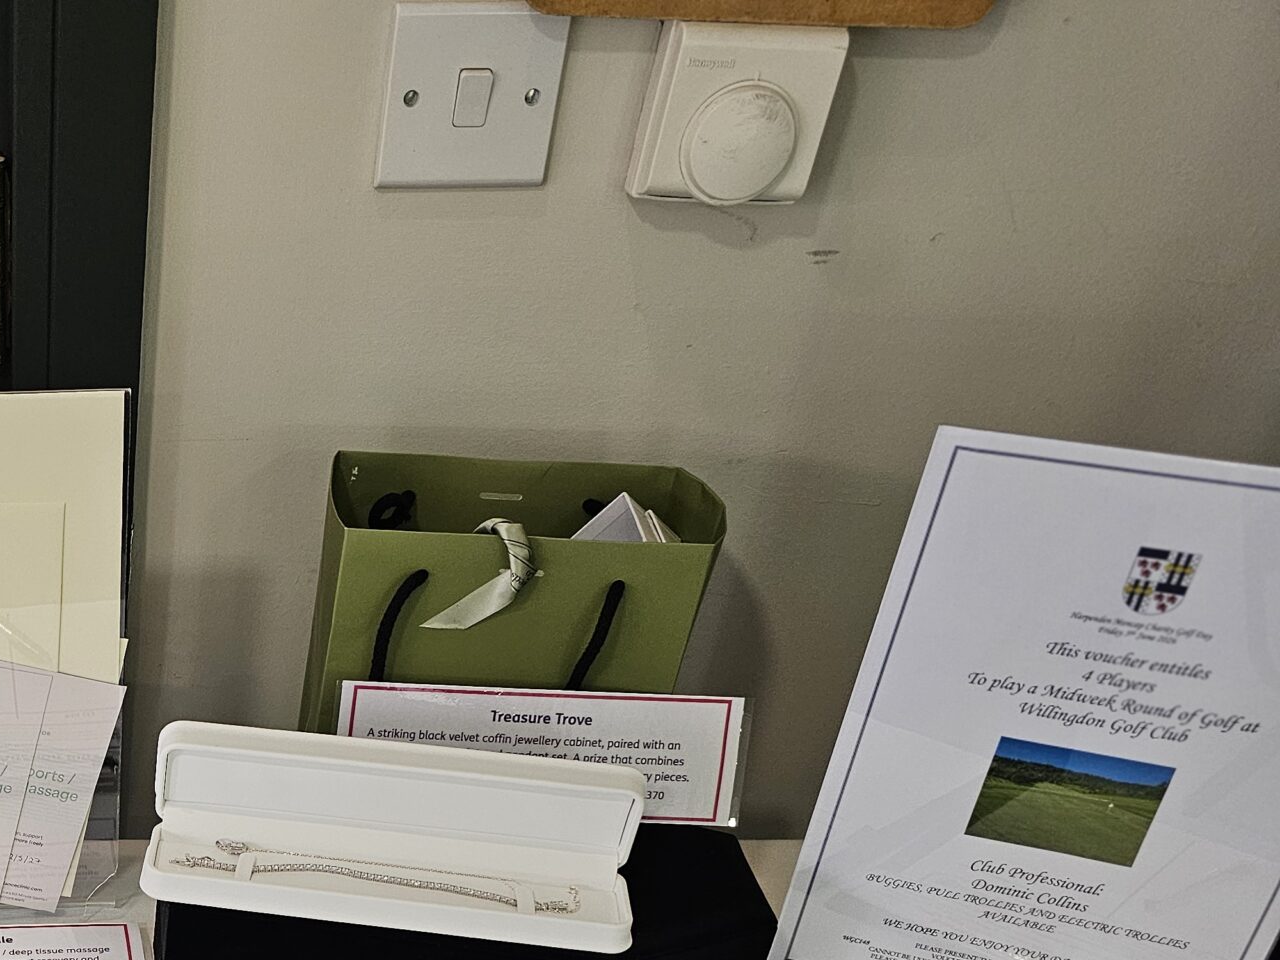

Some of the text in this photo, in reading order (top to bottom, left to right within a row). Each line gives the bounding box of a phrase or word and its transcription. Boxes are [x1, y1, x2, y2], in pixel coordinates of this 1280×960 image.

[1046, 642, 1211, 679] This voucher entitles
[1081, 670, 1157, 693] 4 Players
[968, 672, 1260, 733] To play a Midweek Round of Golf at
[490, 710, 593, 726] Treasure Trove
[1019, 702, 1191, 742] Willingdon Golf Club
[367, 728, 681, 751] A striking black velvet coffin jewellery cabinet, paired with an
[0, 765, 8, 777] /
[654, 771, 689, 784] pieces.
[29, 785, 78, 802] assage
[646, 791, 664, 800] 370
[970, 860, 1105, 896] Club Professional:
[971, 879, 1089, 912] Dominic Collins
